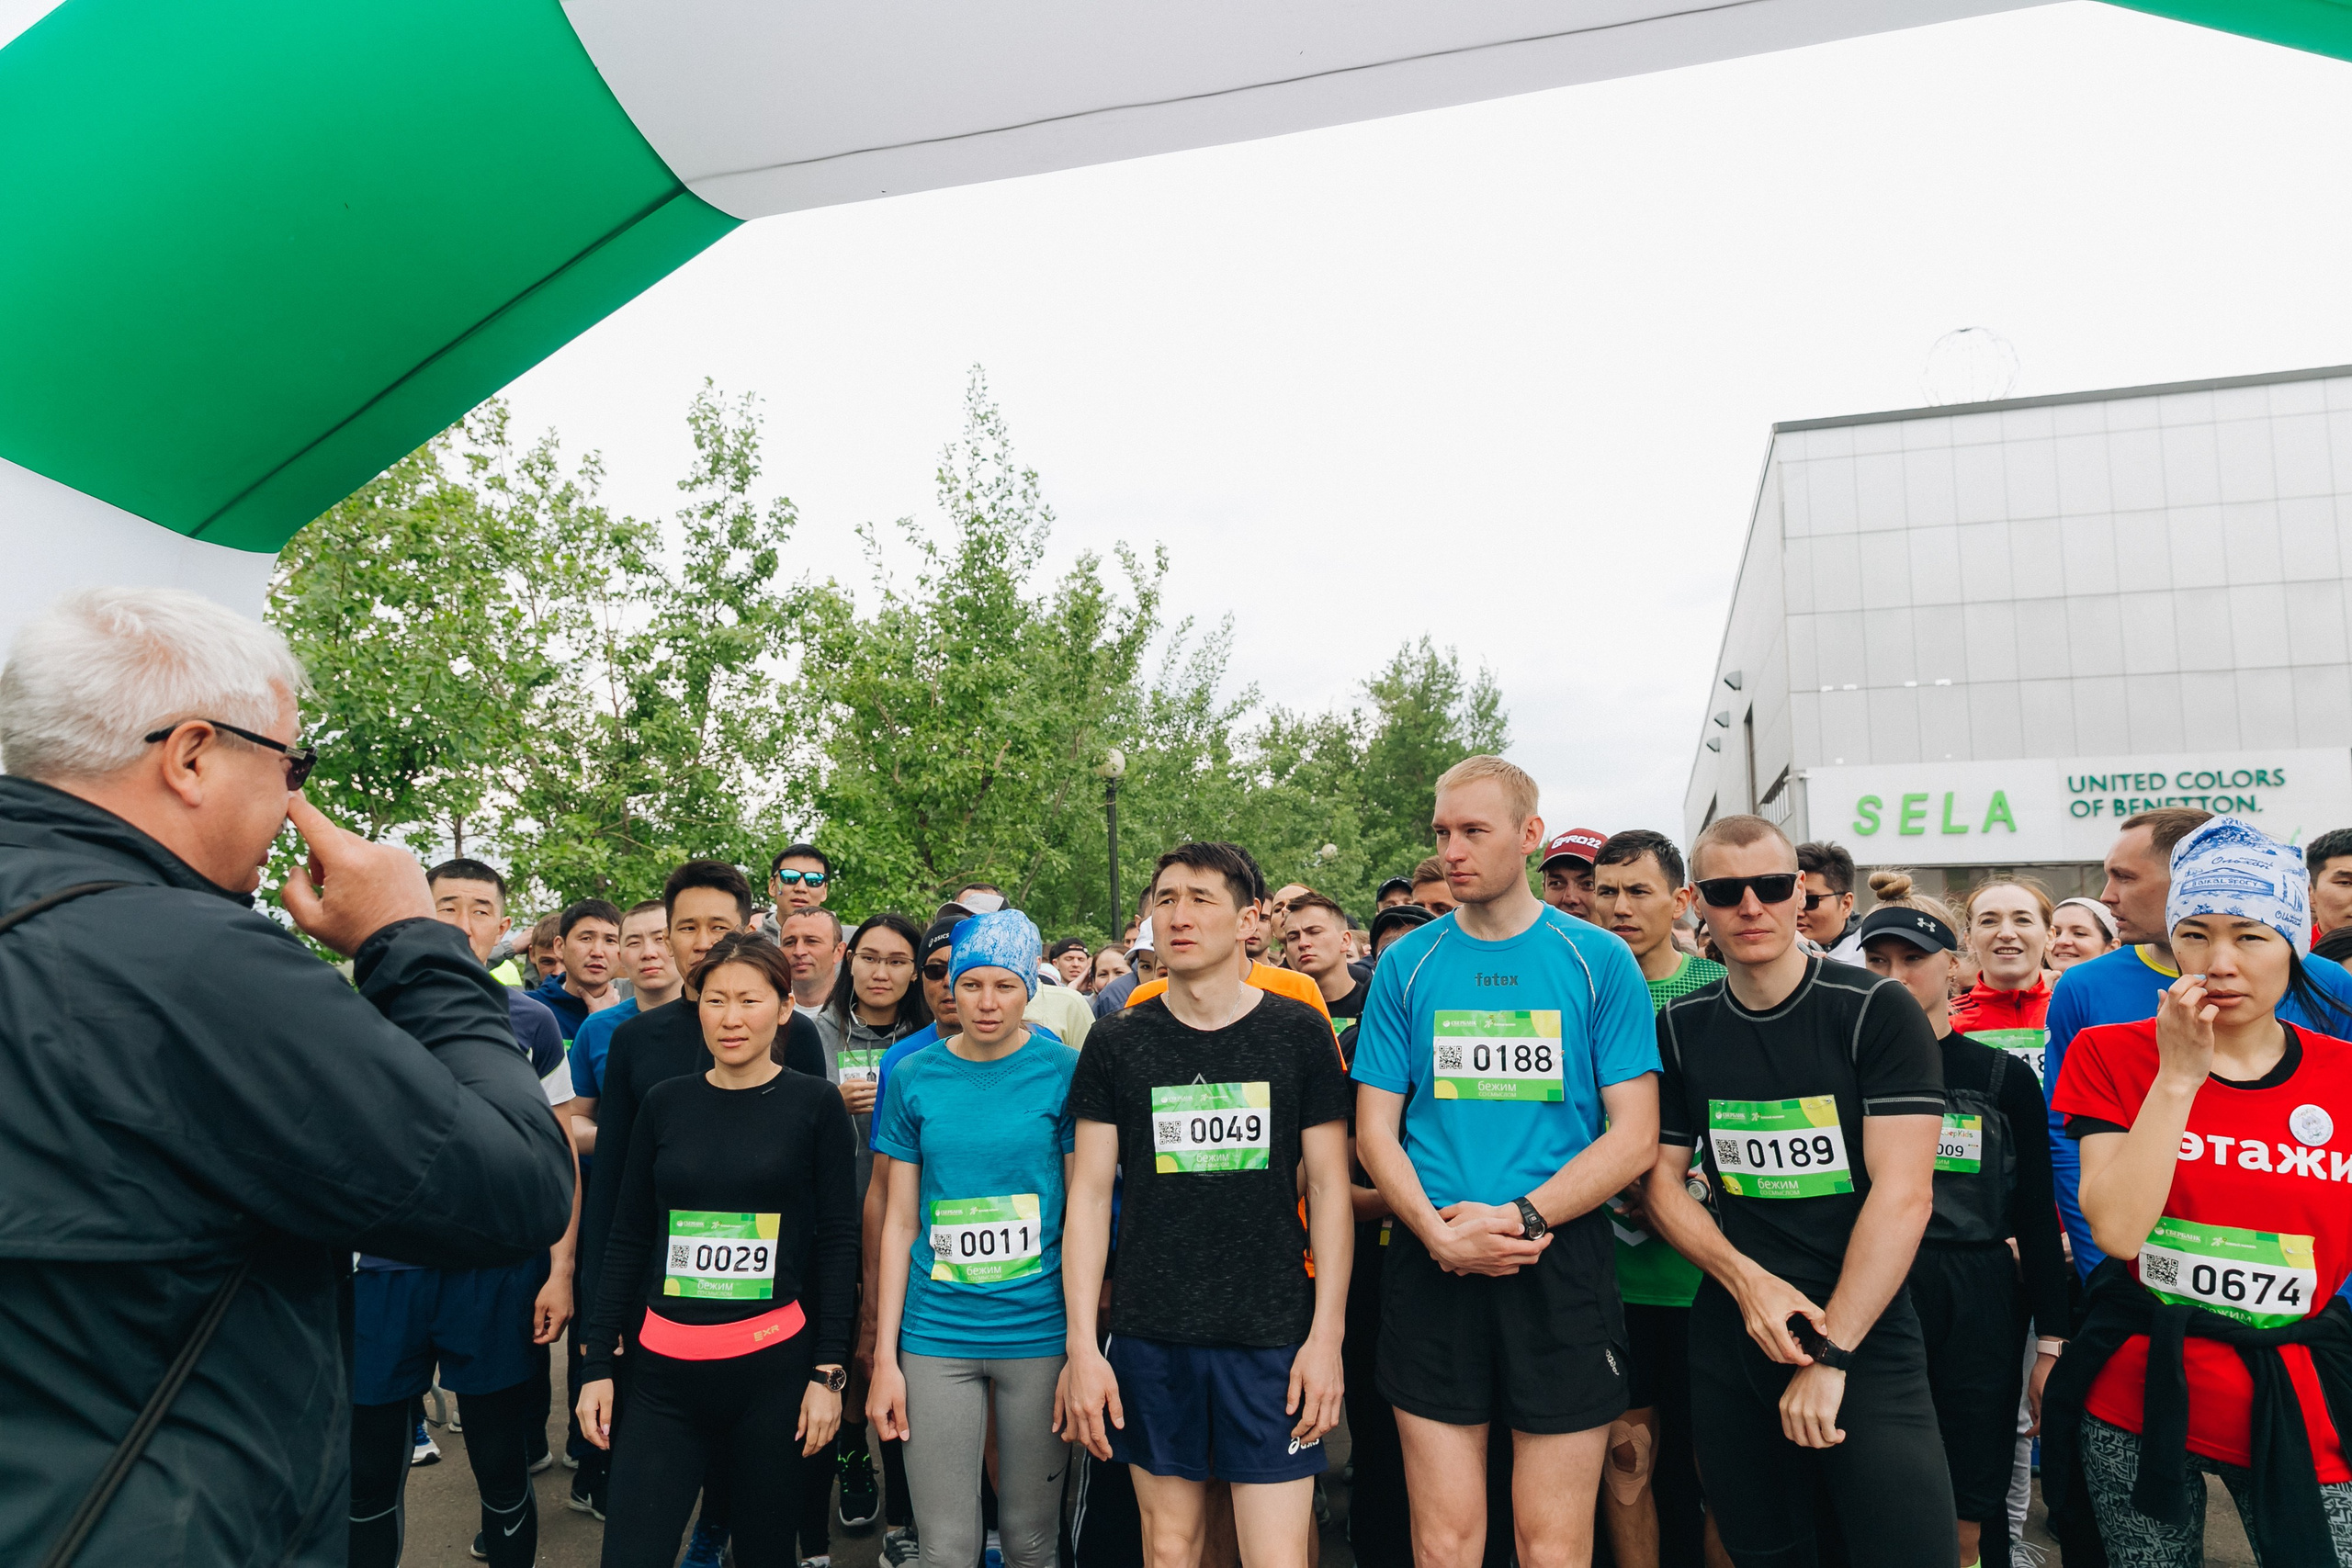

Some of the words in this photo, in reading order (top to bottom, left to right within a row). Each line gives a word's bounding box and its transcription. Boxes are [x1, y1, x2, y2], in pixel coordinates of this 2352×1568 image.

[2068, 773, 2166, 793] UNITED
[2176, 769, 2285, 789] COLORS
[1852, 790, 2018, 836] SELA
[2070, 799, 2104, 818] OF
[1474, 1043, 1553, 1072] 0188
[1477, 1080, 1516, 1092] бежим
[1190, 1115, 1261, 1144] 0049
[1196, 1152, 1229, 1163] бежим
[1747, 1135, 1835, 1168] 0189
[1757, 1178, 1799, 1190] бежим
[960, 1226, 1028, 1257] 0011
[2165, 1229, 2201, 1243] СБЕРБАНК
[696, 1245, 768, 1272] 0029
[966, 1266, 1001, 1276] бежим
[697, 1279, 733, 1291] бежим
[2192, 1264, 2300, 1306] 0674
[753, 1325, 779, 1342] EXR
